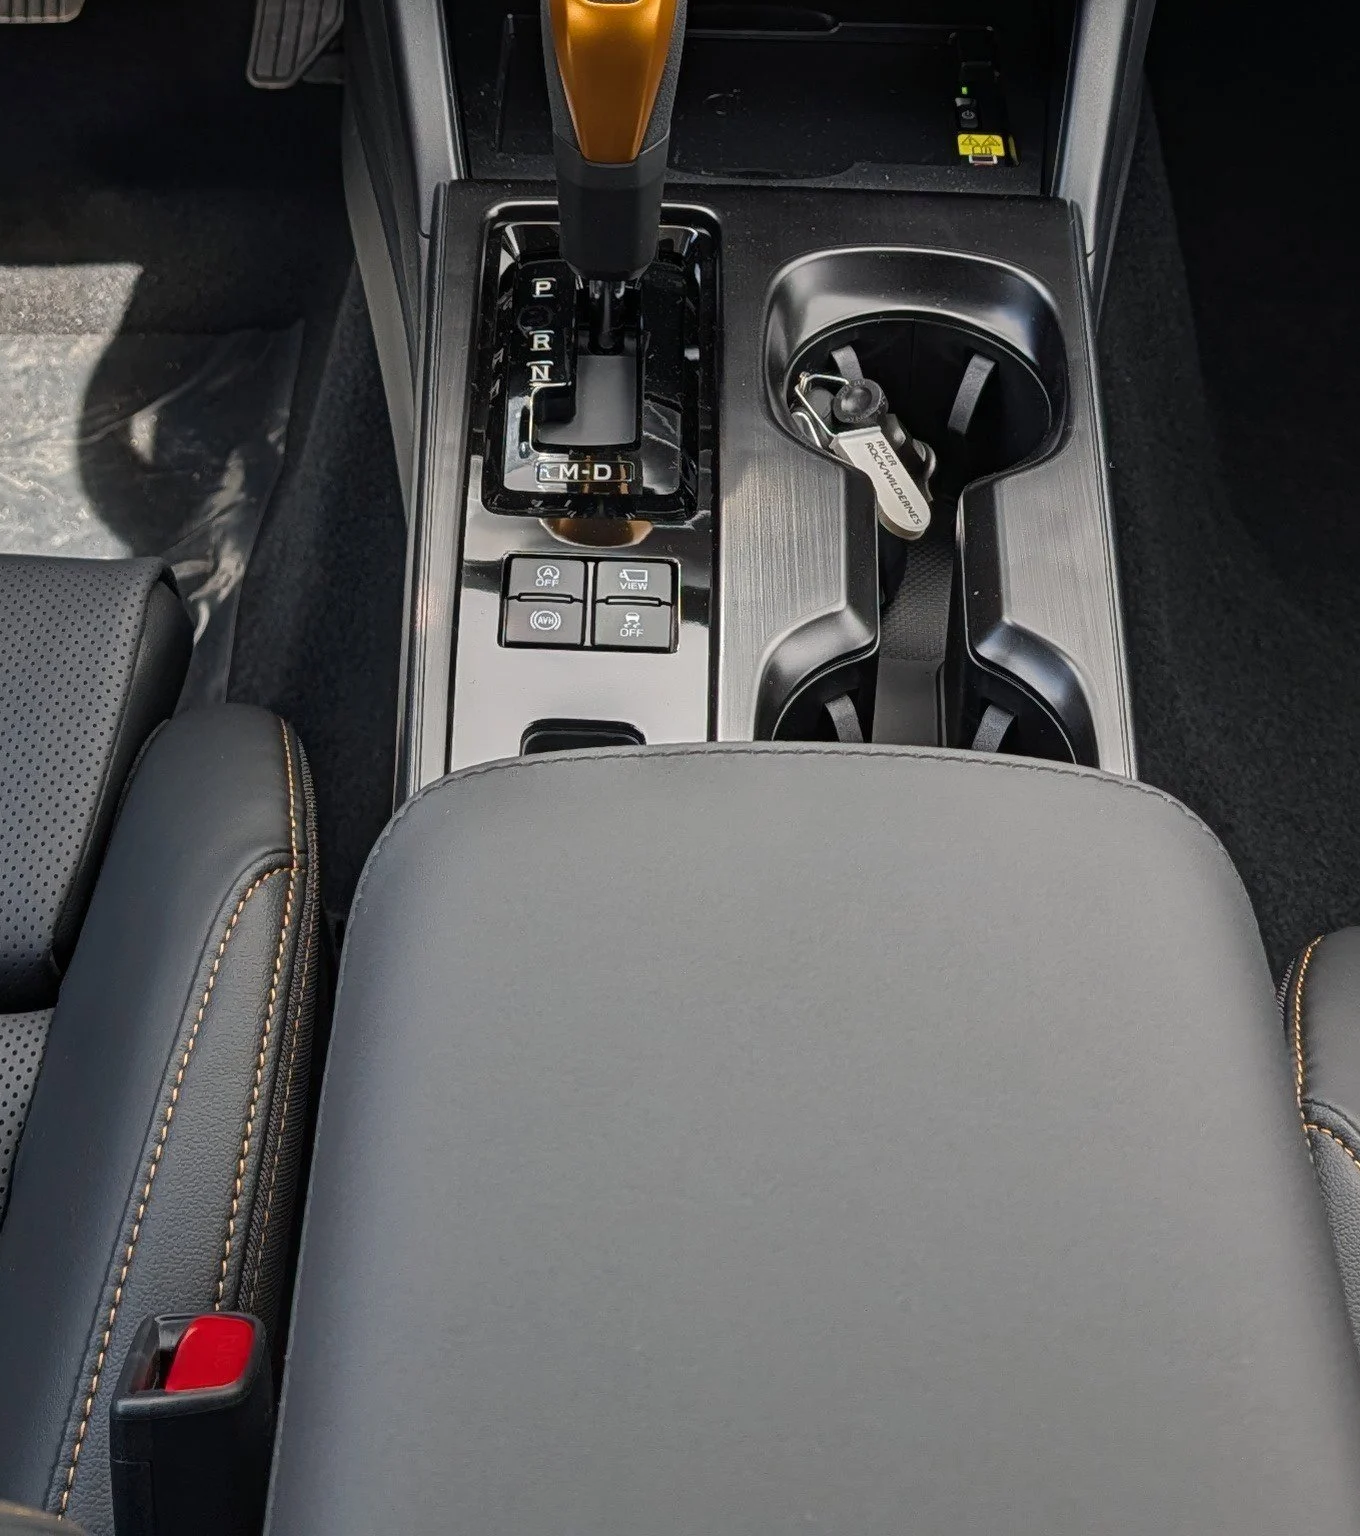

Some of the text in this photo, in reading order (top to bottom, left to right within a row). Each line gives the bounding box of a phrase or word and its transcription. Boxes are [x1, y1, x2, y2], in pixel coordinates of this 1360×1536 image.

[535, 280, 552, 295] P
[533, 334, 550, 350] R
[531, 365, 550, 382] N
[876, 440, 897, 467] RIVER
[558, 463, 612, 480] M-D
[542, 568, 555, 577] A
[535, 578, 560, 588] OFF
[620, 582, 648, 591] VIEW
[620, 628, 644, 638] OFF
